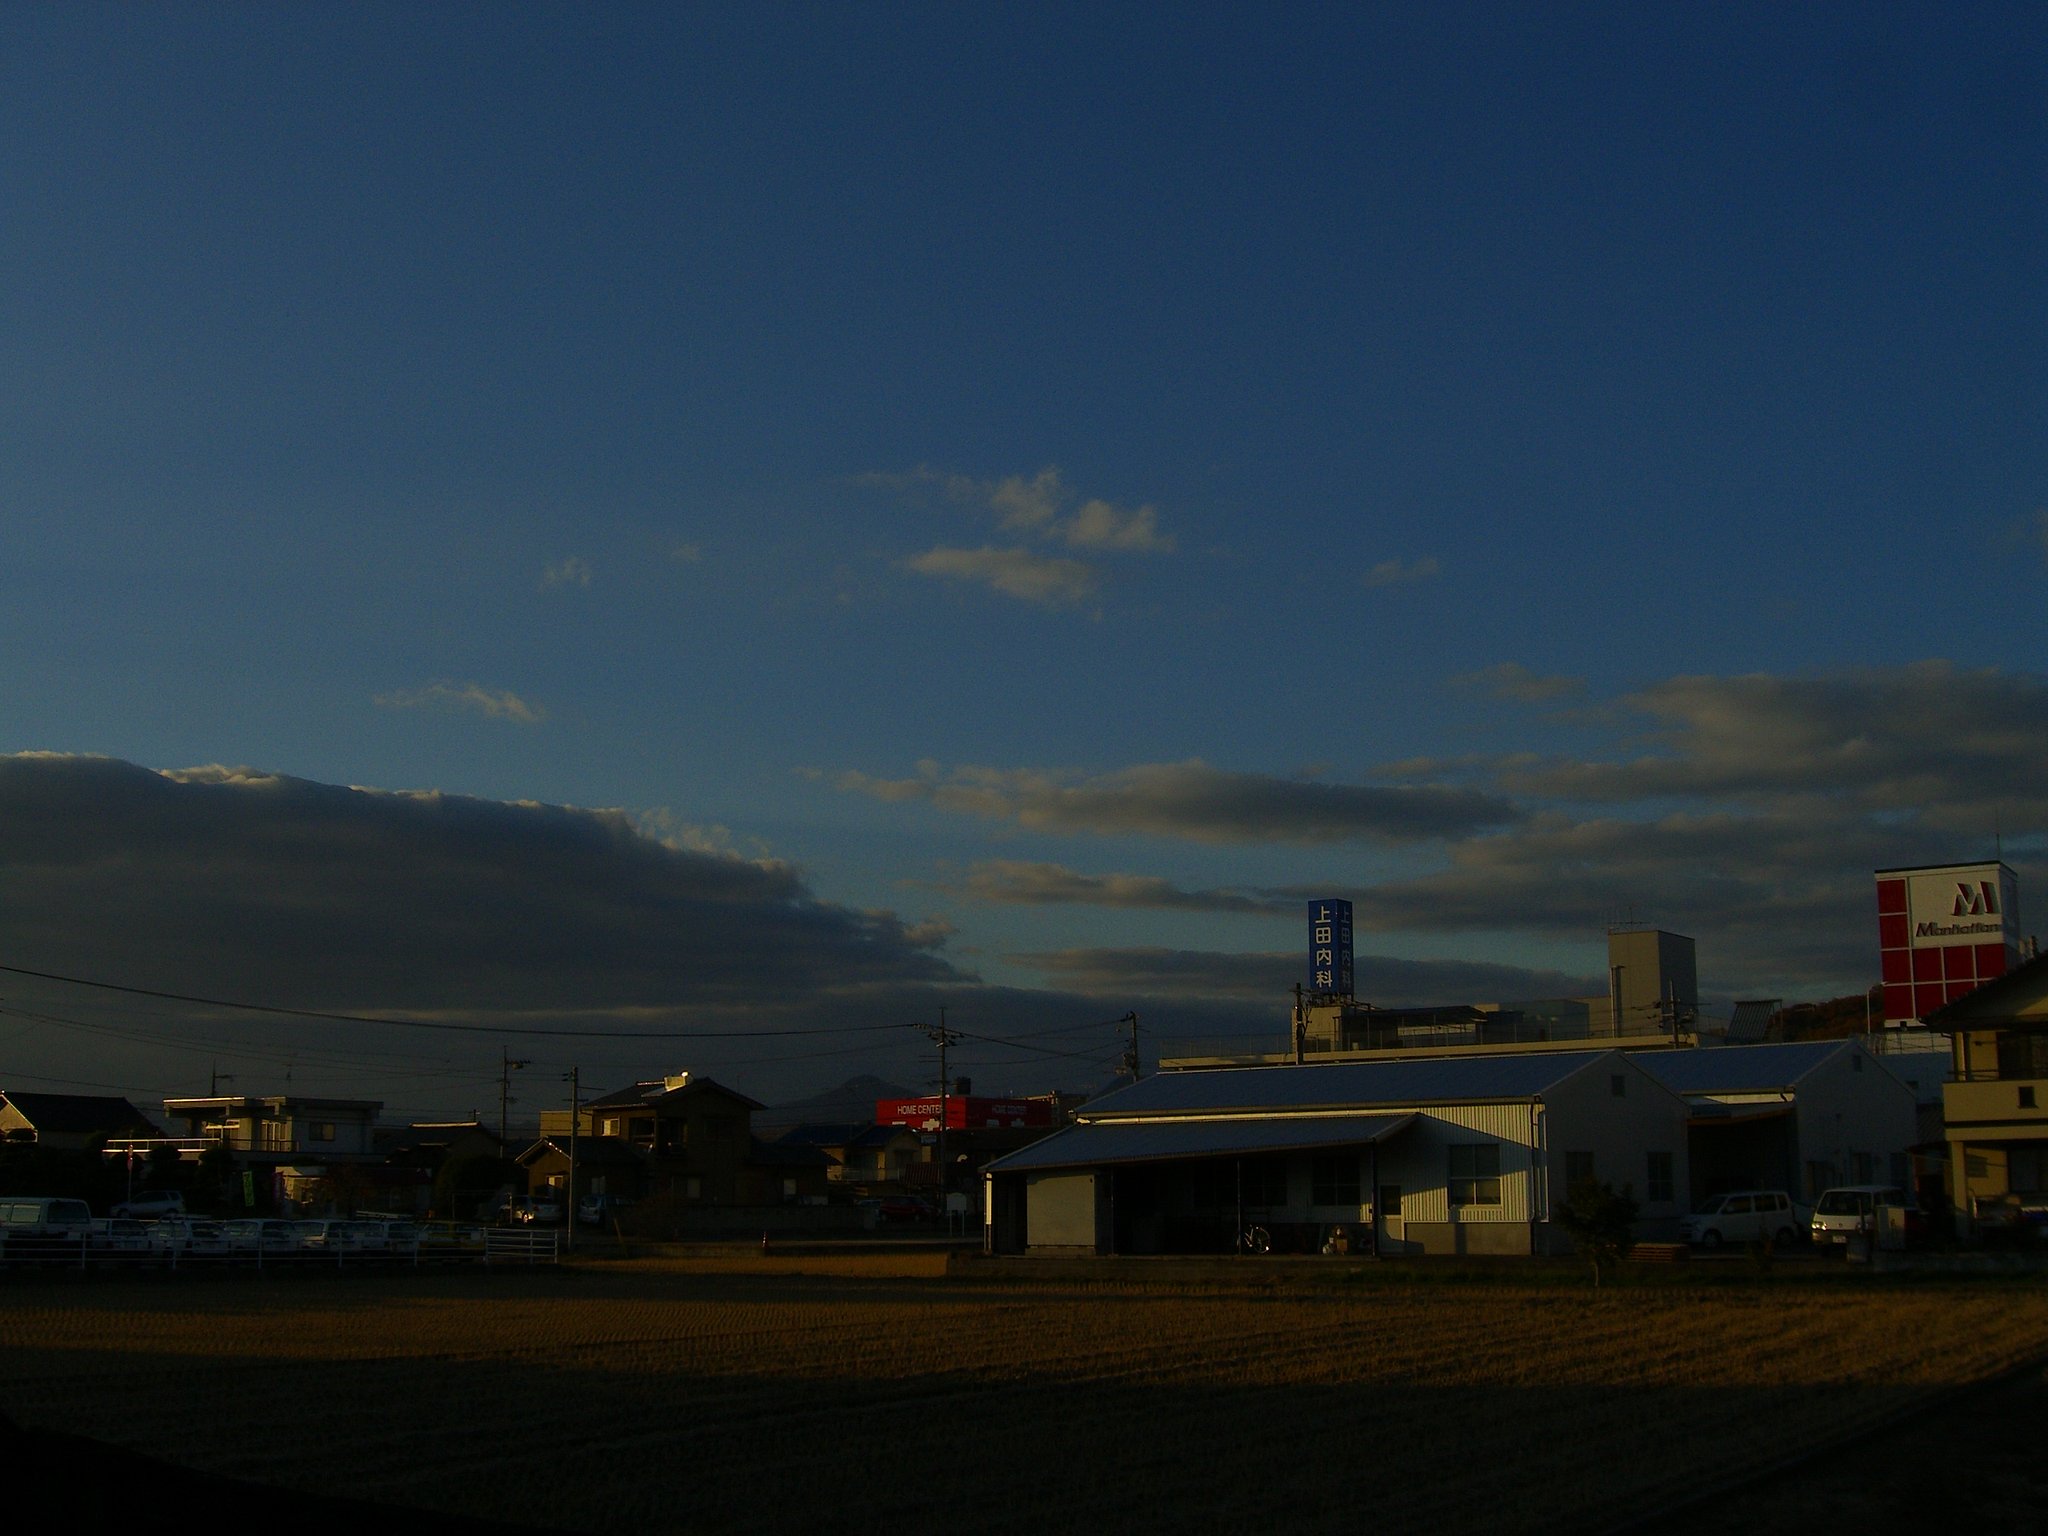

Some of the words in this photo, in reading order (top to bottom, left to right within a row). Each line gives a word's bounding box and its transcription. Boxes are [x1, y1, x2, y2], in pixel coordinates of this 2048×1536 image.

[1916, 921, 2000, 937] Manhattan
[1314, 905, 1333, 988] 上田内科
[897, 1105, 917, 1115] HOME
